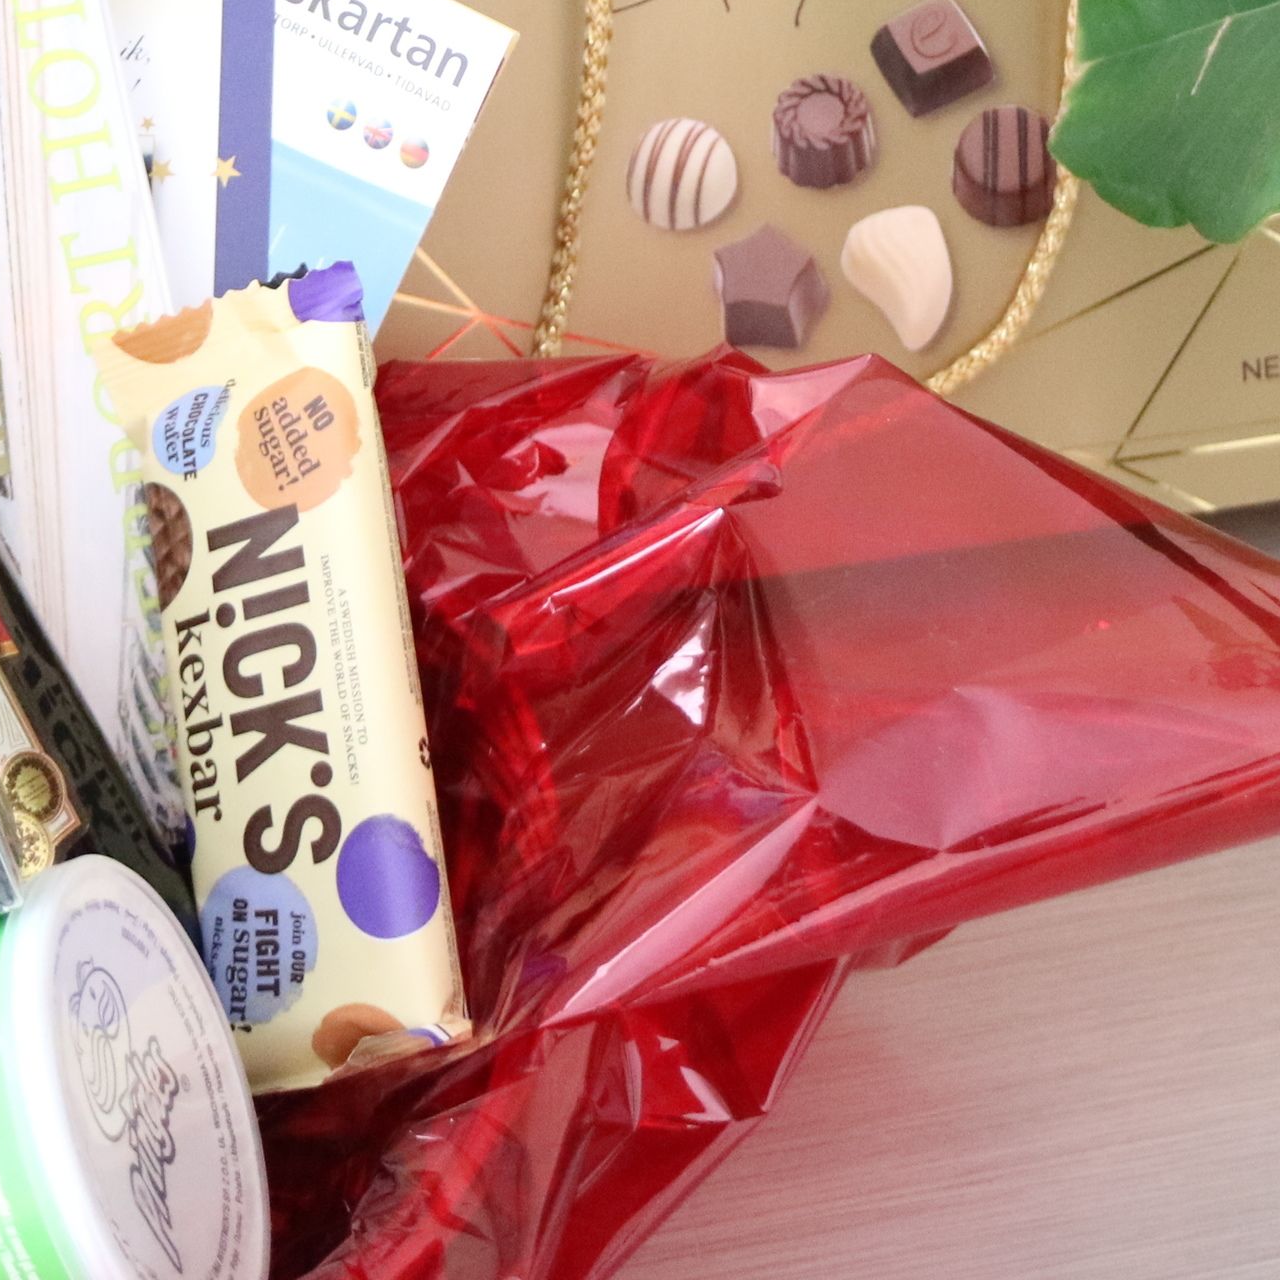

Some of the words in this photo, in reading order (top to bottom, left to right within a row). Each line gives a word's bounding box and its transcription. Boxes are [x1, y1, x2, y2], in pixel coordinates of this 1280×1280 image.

[165, 406, 179, 462] wafer
[182, 393, 208, 481] CHOCOLATE
[272, 397, 321, 477] added
[304, 395, 334, 432] NO
[254, 406, 300, 491] sugar!
[318, 554, 336, 615] IMPROVE
[336, 587, 347, 597] A
[327, 620, 341, 647] THE
[338, 599, 356, 661] SWEDISH
[331, 650, 348, 699] WORLD
[347, 664, 365, 723] MISSION
[174, 608, 223, 823] kexbar
[339, 703, 351, 721] OF
[356, 726, 368, 745] TO
[342, 724, 360, 785] SNACKS!
[233, 898, 248, 923] ON
[290, 911, 306, 945] join
[225, 928, 252, 1034] sugar!
[255, 909, 280, 997] FIGHT
[290, 950, 306, 984] OUR
[128, 1035, 184, 1276] Pringles
